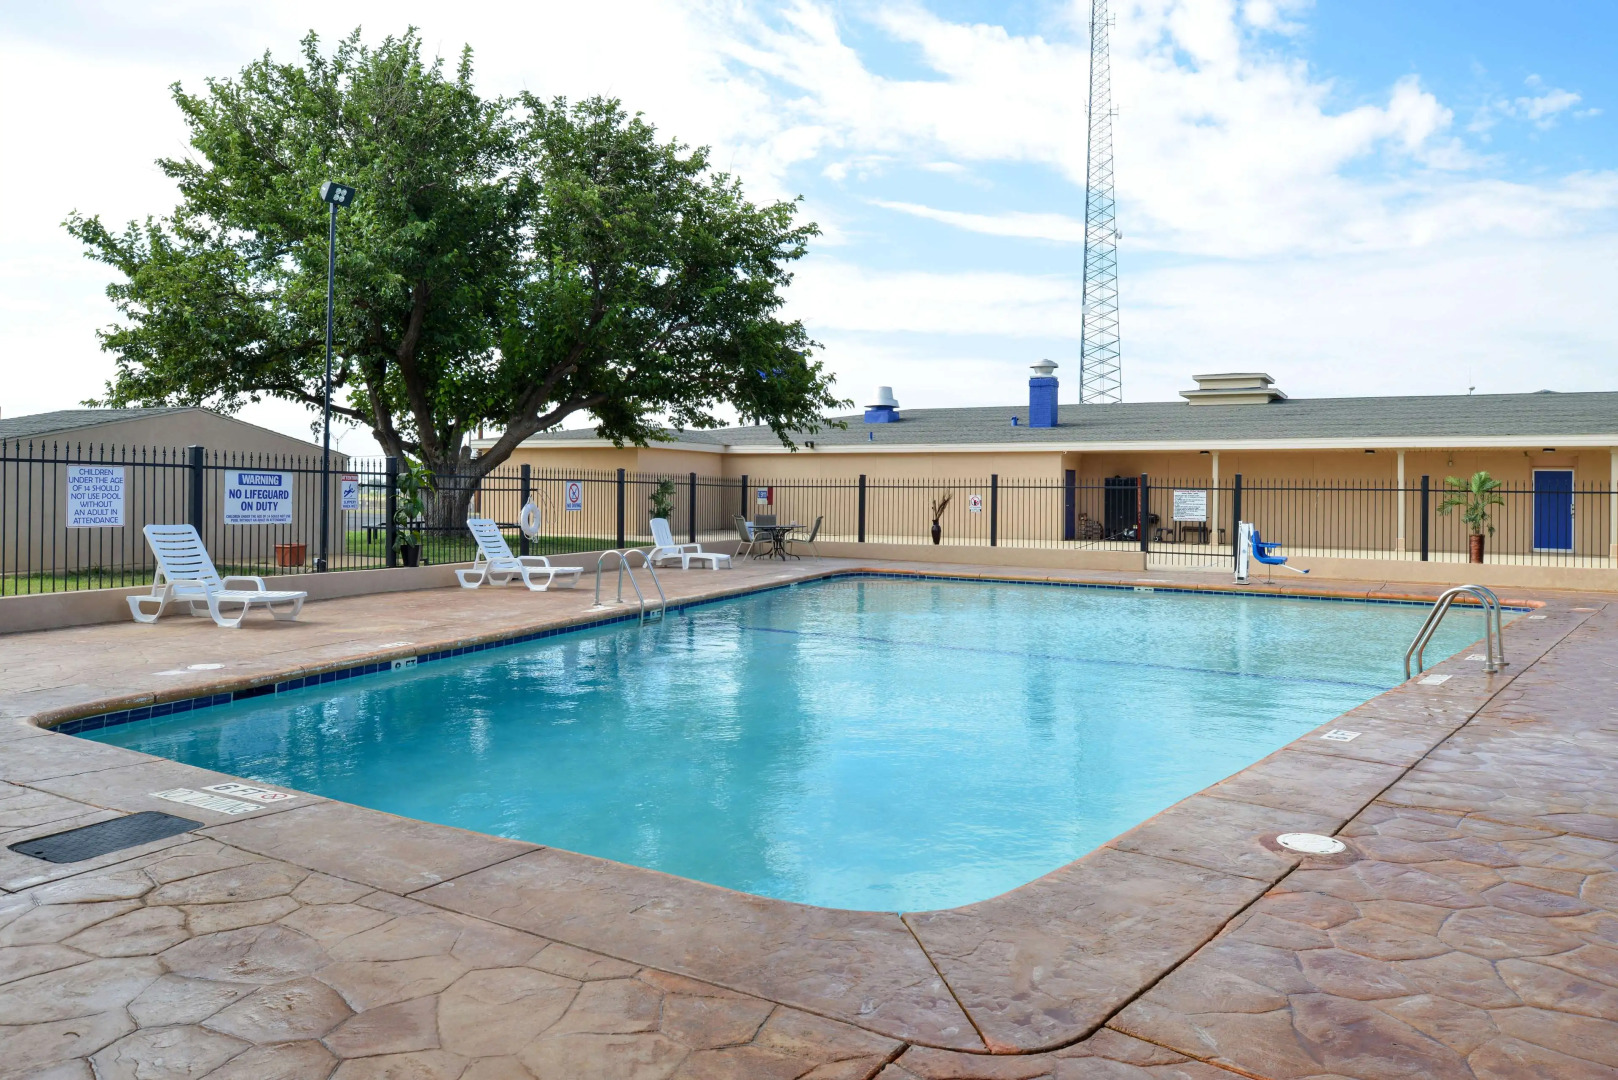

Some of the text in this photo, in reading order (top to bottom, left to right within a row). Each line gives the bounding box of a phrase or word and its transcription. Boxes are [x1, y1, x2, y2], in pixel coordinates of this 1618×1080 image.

[79, 468, 114, 476] CHILDREN
[68, 476, 93, 484] UNDER
[242, 474, 279, 486] WARNING
[228, 488, 289, 500] NO LIFEGUARD
[240, 500, 278, 512] ON DUTY
[231, 788, 269, 796] FT
